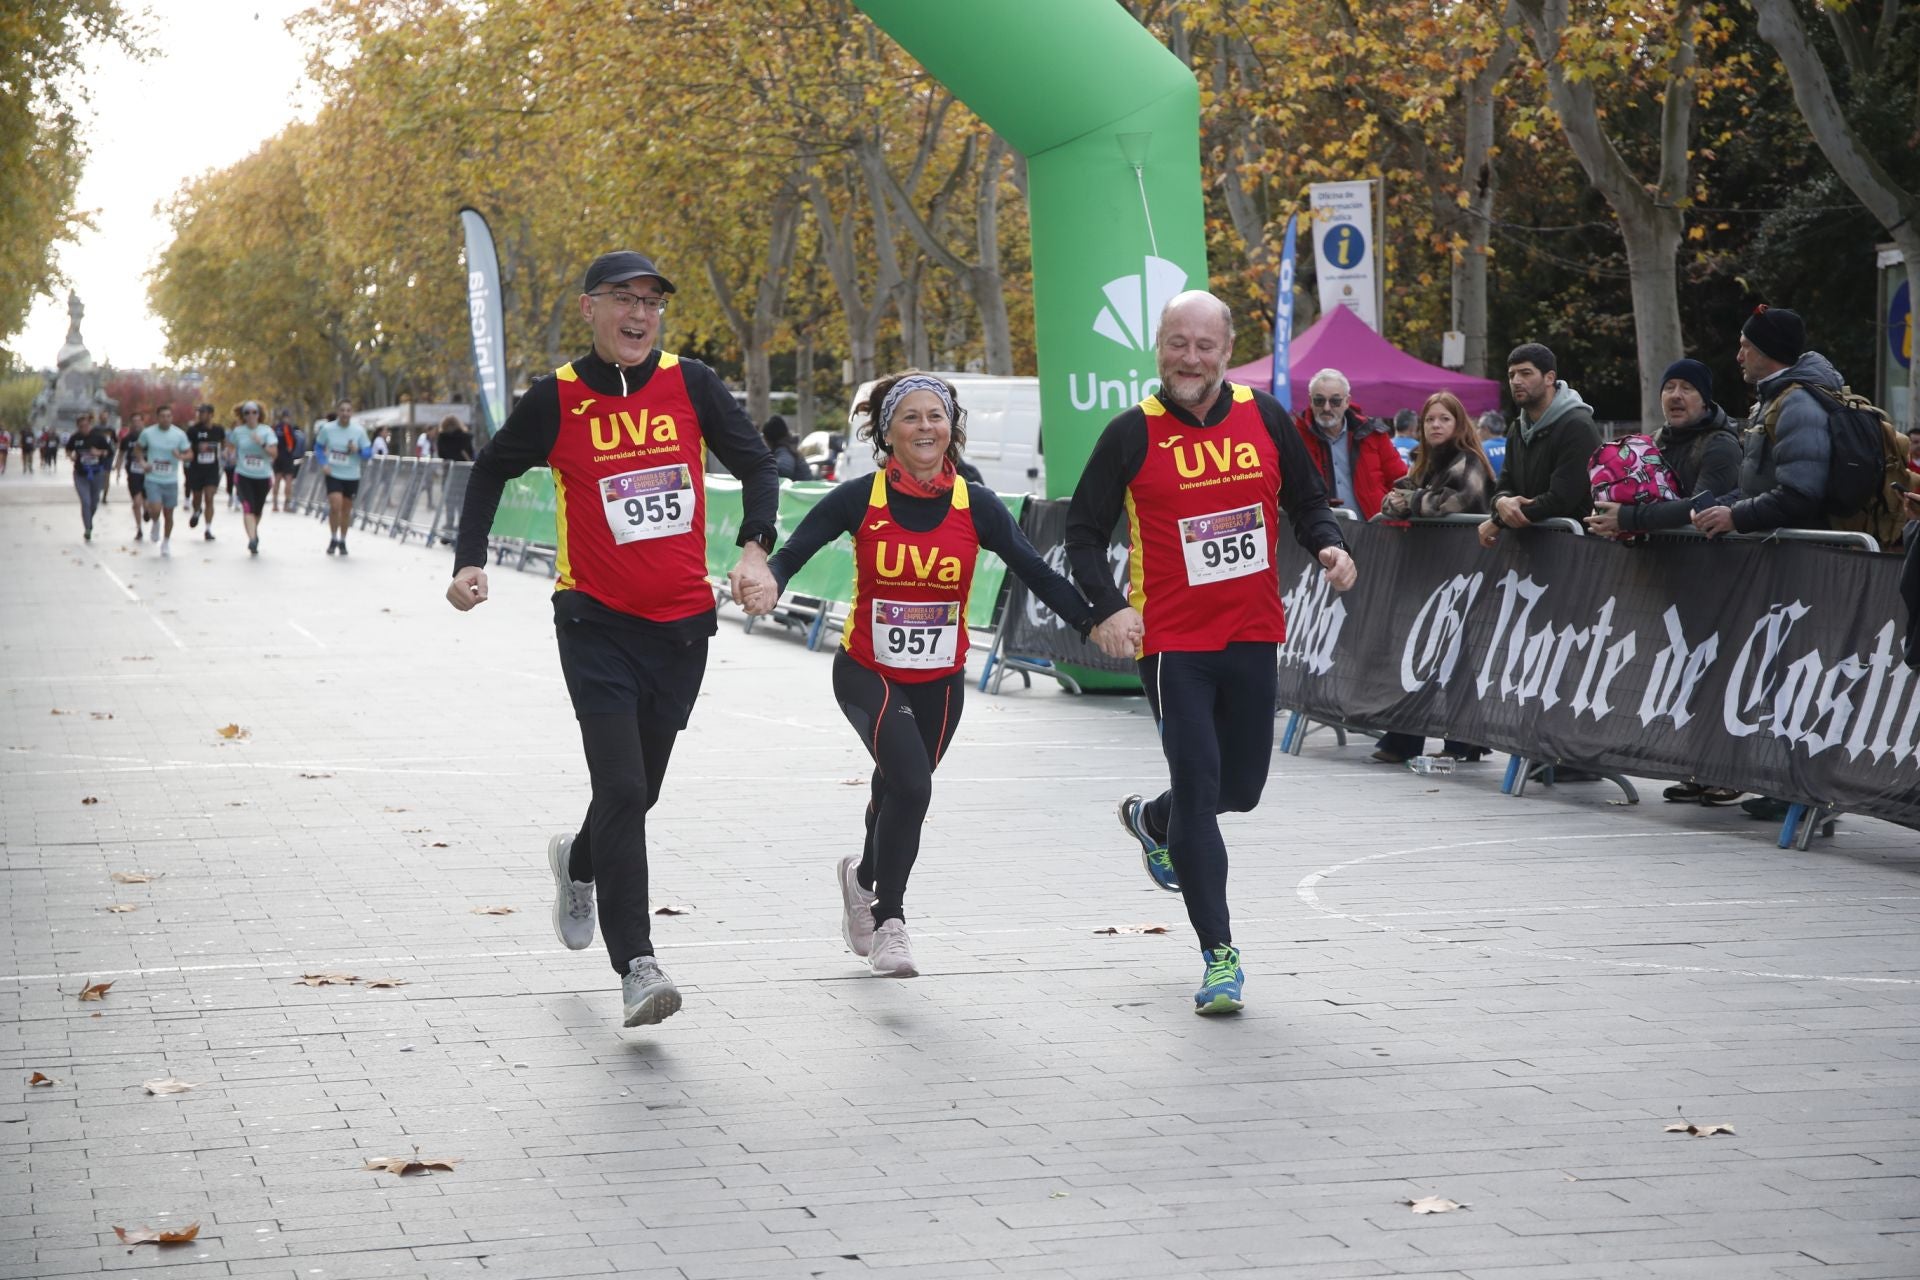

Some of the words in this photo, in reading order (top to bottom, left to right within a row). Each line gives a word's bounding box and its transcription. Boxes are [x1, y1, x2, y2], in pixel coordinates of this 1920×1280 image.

[1068, 369, 1163, 411] Unic
[590, 408, 678, 451] UVa
[593, 450, 636, 463] Universidad
[647, 444, 681, 455] Valladolid
[1173, 437, 1261, 479] UVa
[632, 473, 658, 483] CARRERA
[658, 471, 667, 479] DE
[633, 477, 668, 490] EMPRESAS
[1179, 477, 1221, 490] Universidad
[1231, 471, 1264, 482] Valladolid
[623, 492, 681, 526] 955
[1212, 520, 1244, 532] EMPRESAS
[875, 540, 962, 583] UVa
[1201, 533, 1256, 568] 956
[876, 579, 917, 587] Universidad
[927, 581, 960, 590] Valladolid
[903, 612, 935, 620] EMPRESAS
[888, 627, 943, 655] 957
[1475, 568, 1637, 722] Norte
[1636, 603, 1720, 732] de
